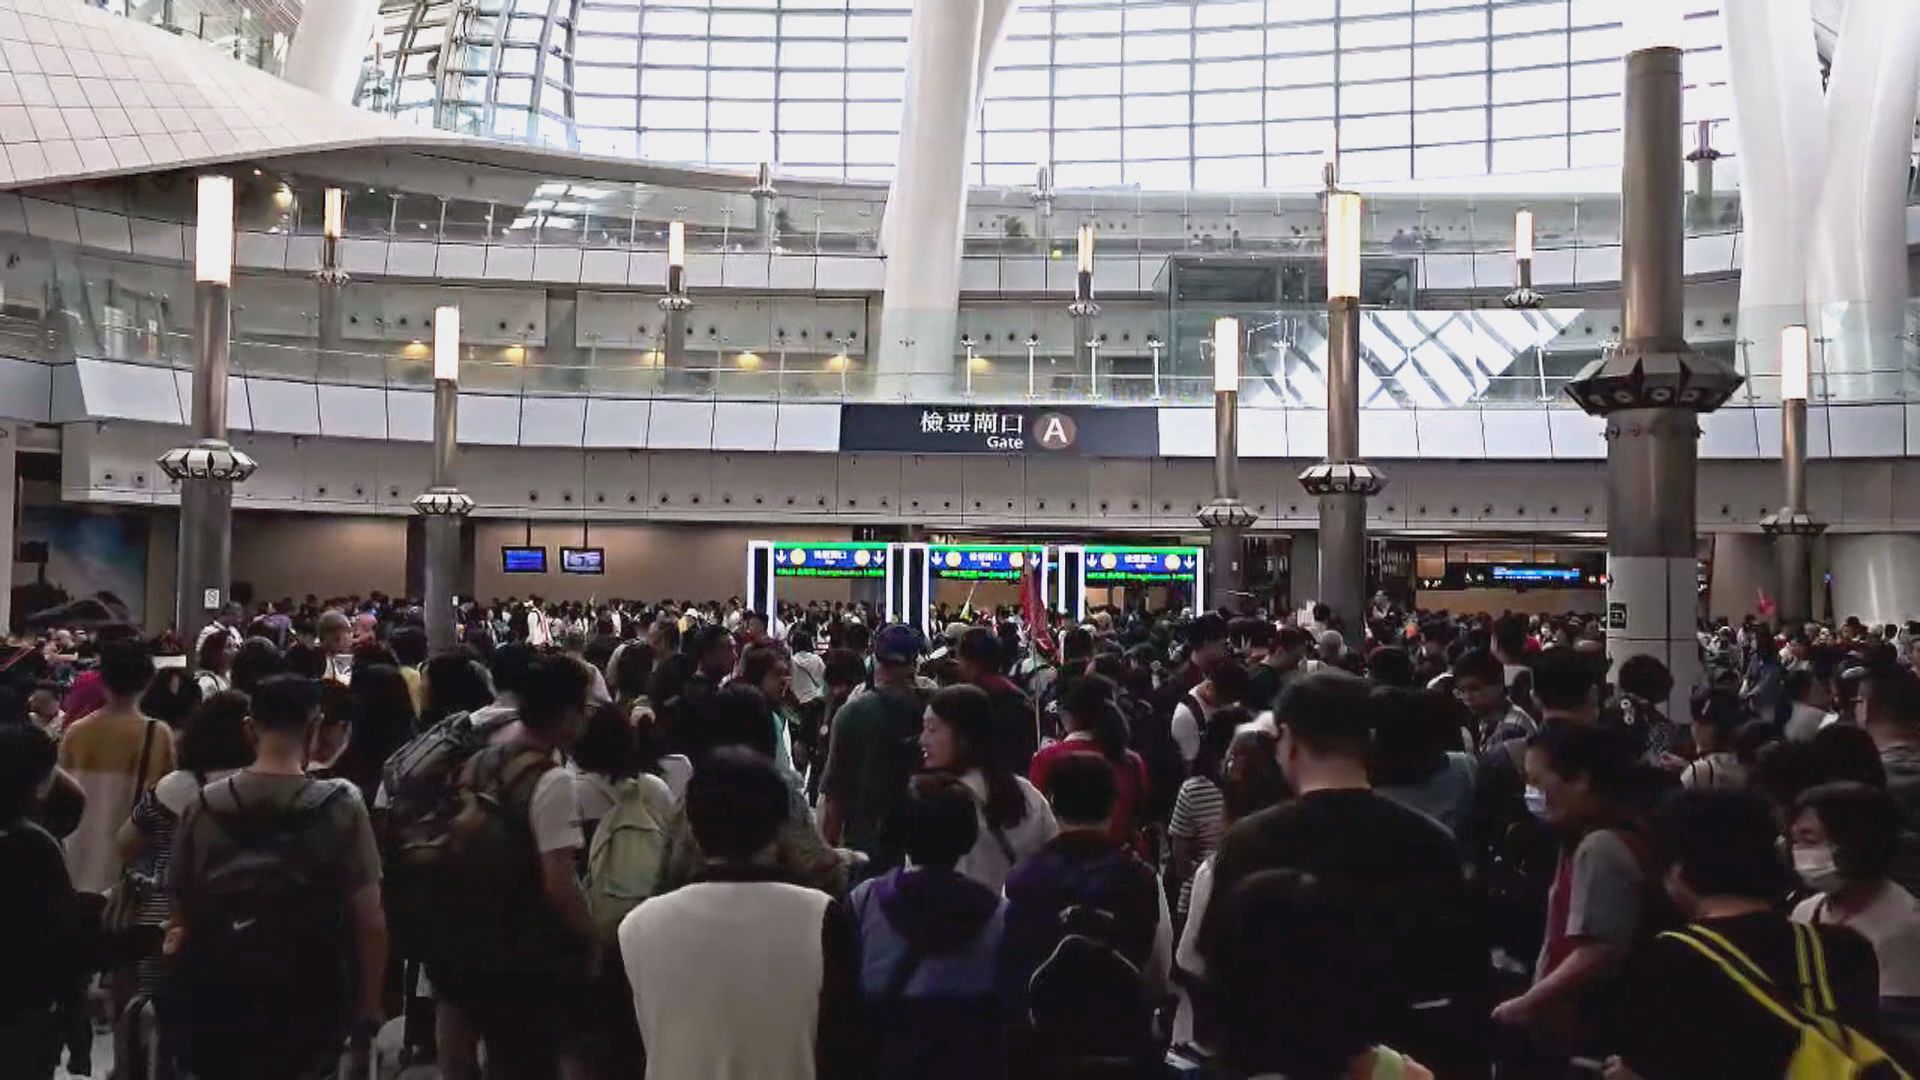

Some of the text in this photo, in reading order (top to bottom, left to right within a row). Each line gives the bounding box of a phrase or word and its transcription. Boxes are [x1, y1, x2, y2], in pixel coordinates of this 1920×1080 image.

[920, 411, 1023, 433] 檢票閘口
[1042, 418, 1068, 443] A
[986, 436, 1024, 449] Gate
